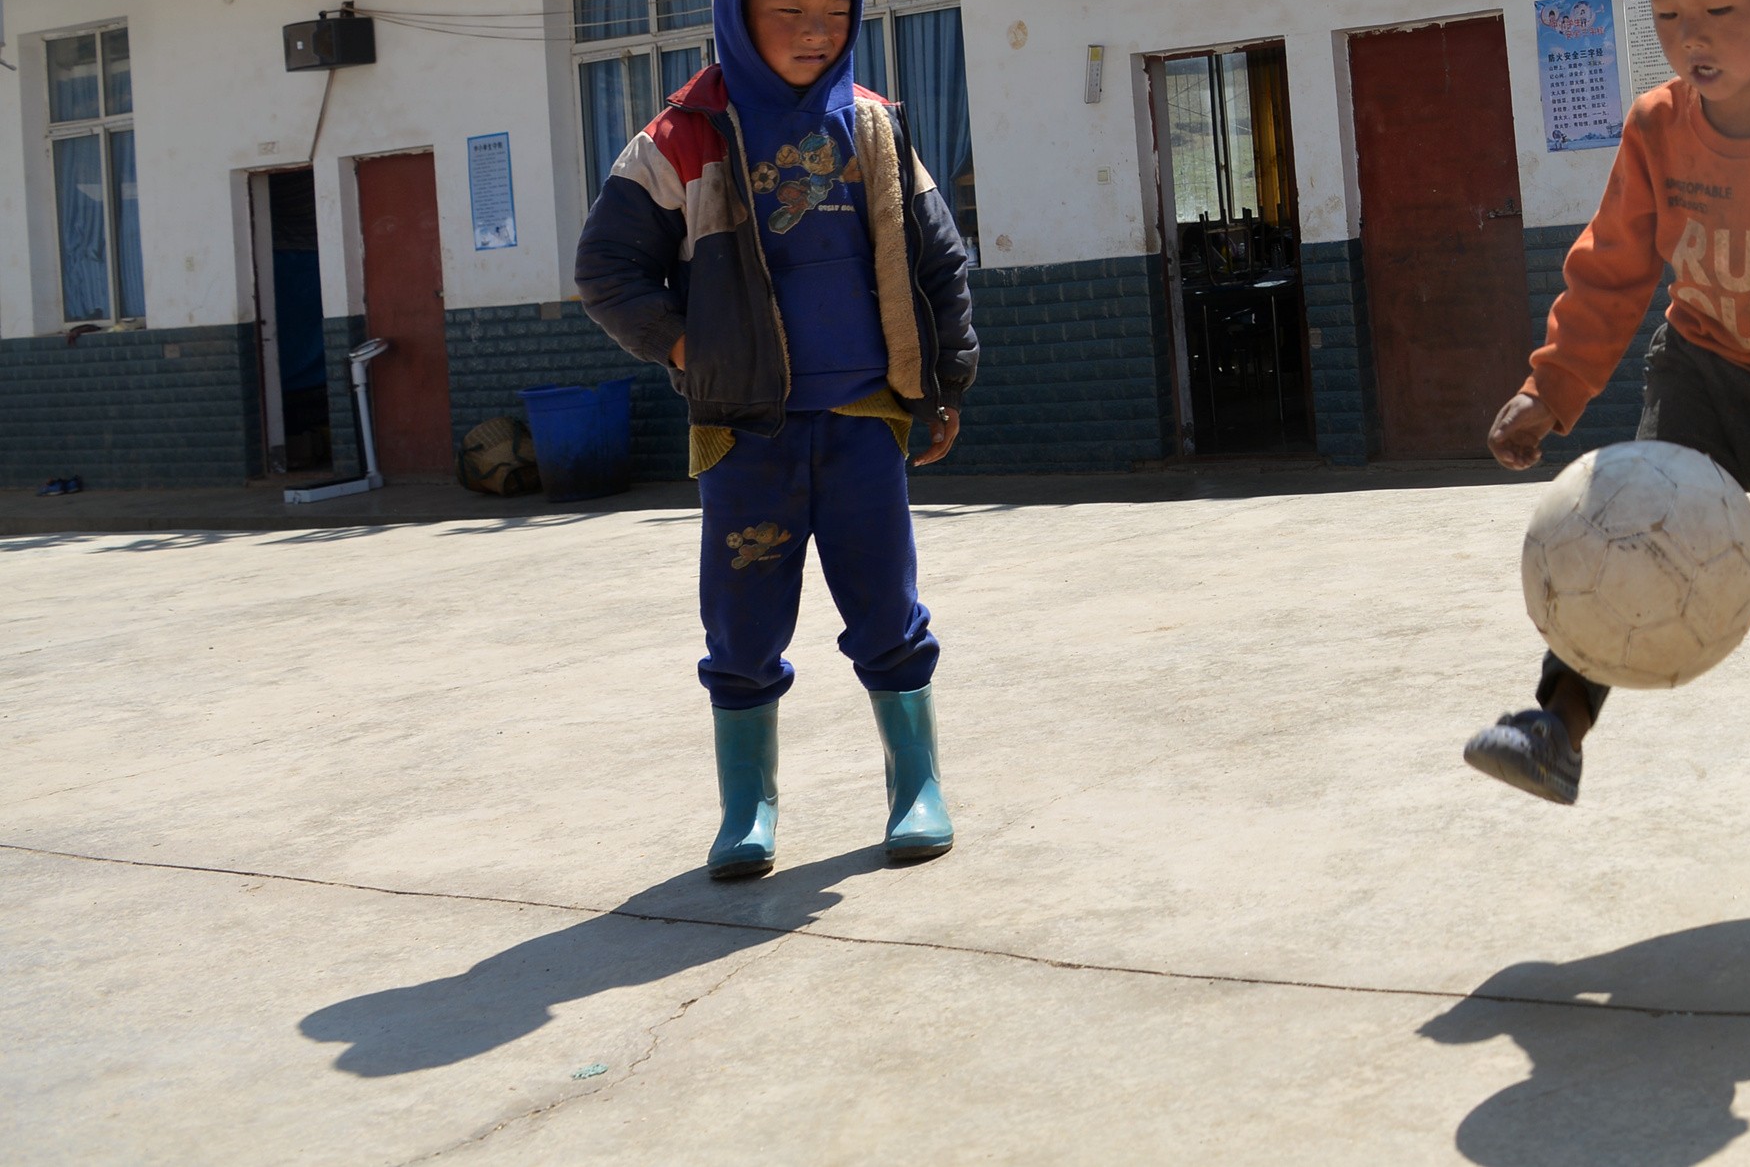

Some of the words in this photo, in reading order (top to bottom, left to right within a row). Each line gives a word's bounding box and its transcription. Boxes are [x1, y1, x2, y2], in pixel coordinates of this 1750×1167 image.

[1548, 48, 1603, 63] 防火安全三字经
